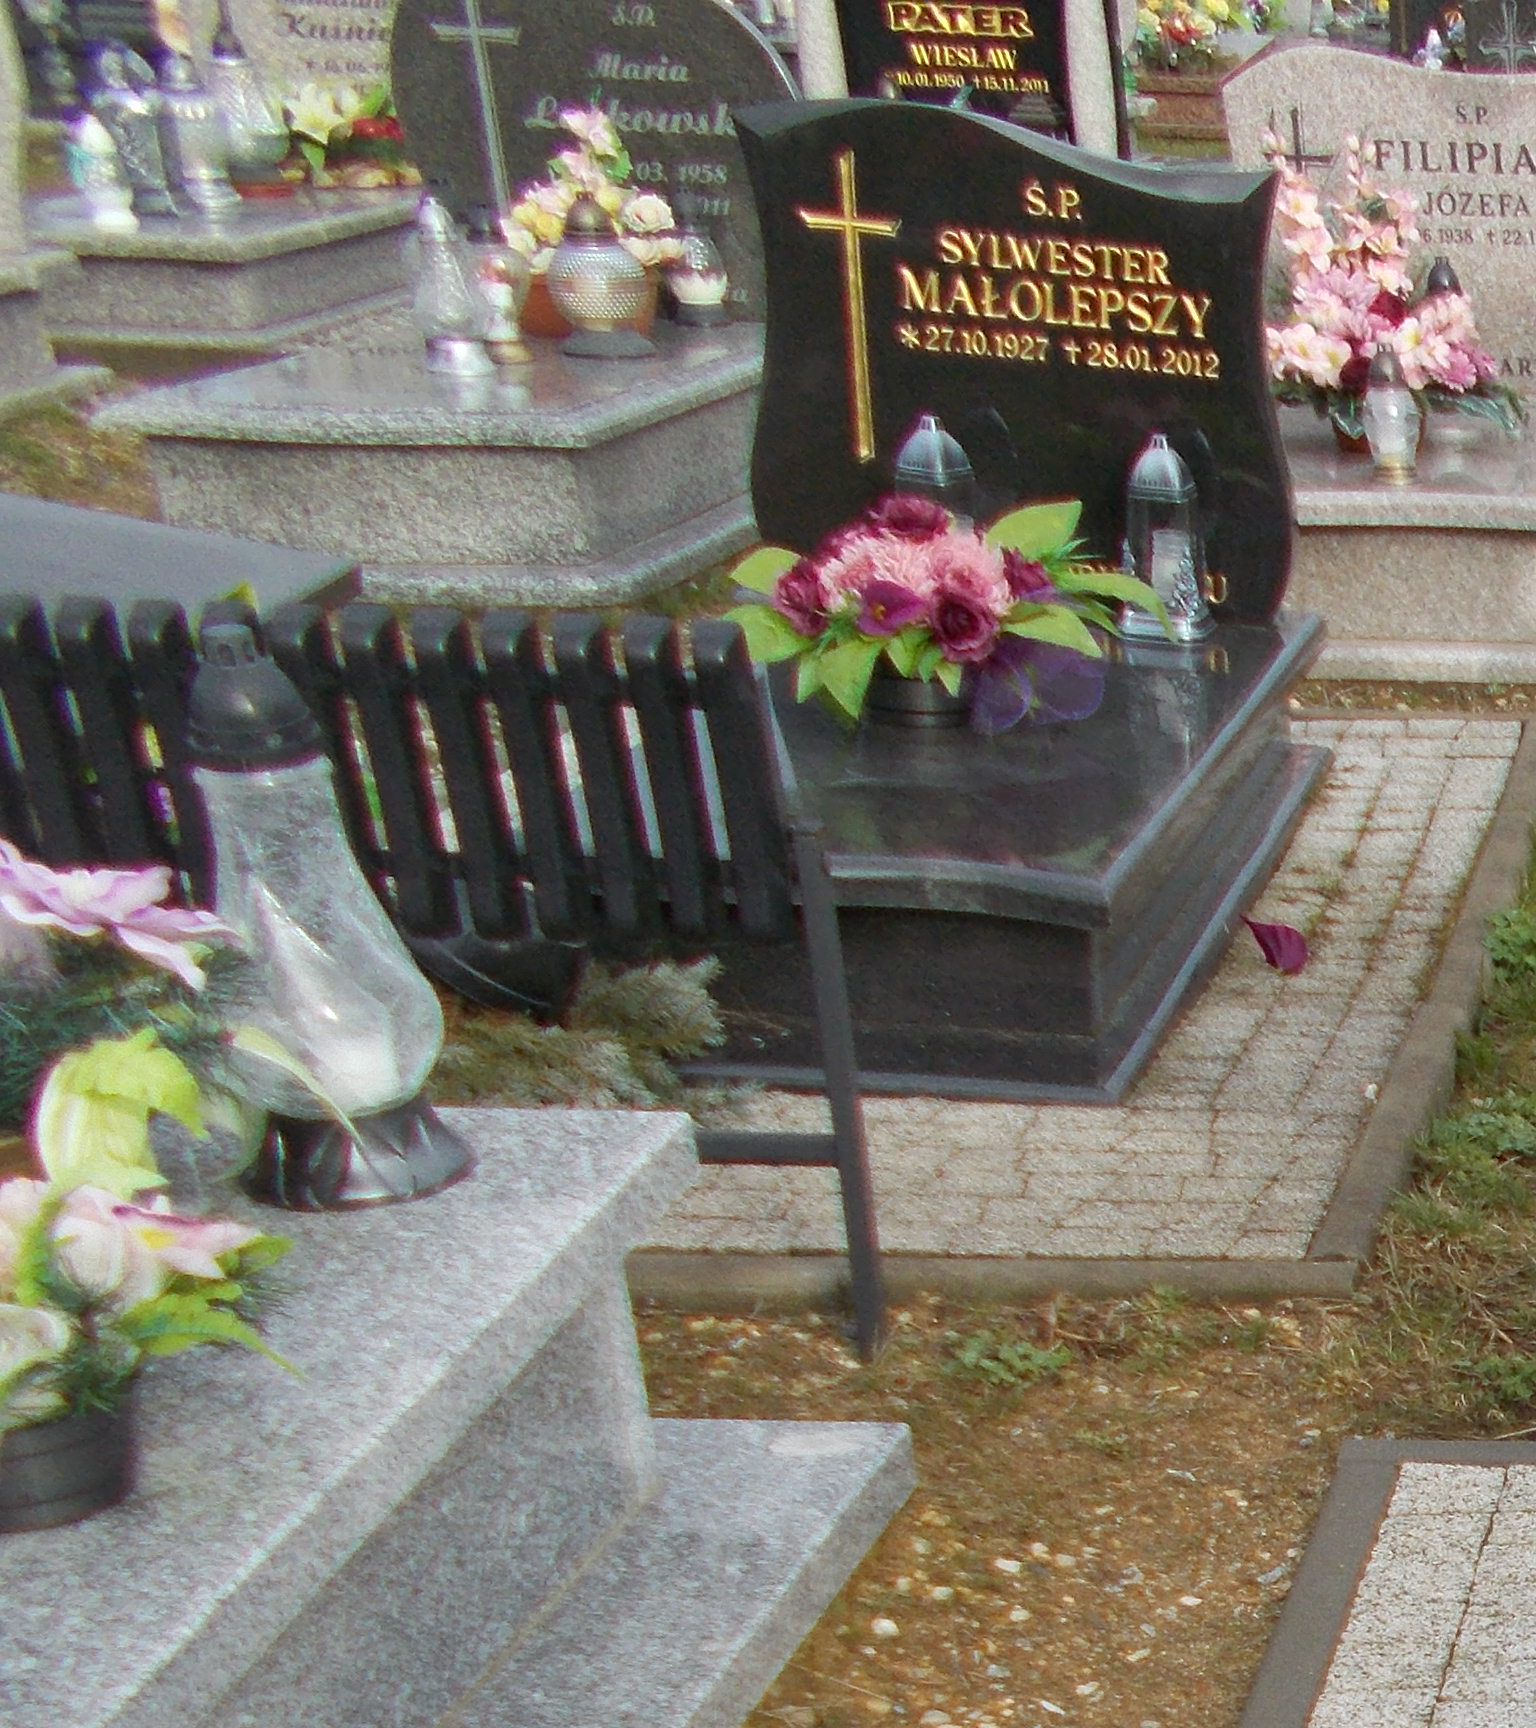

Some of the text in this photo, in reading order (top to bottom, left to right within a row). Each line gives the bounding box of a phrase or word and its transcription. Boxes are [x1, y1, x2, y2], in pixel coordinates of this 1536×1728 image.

[888, 2, 1034, 38] PATER
[589, 53, 689, 82] Maria
[1422, 185, 1531, 217] JÓZEFA
[939, 229, 1171, 286] SYLWESTER
[899, 264, 1213, 339] MAŁOLEPSZY
